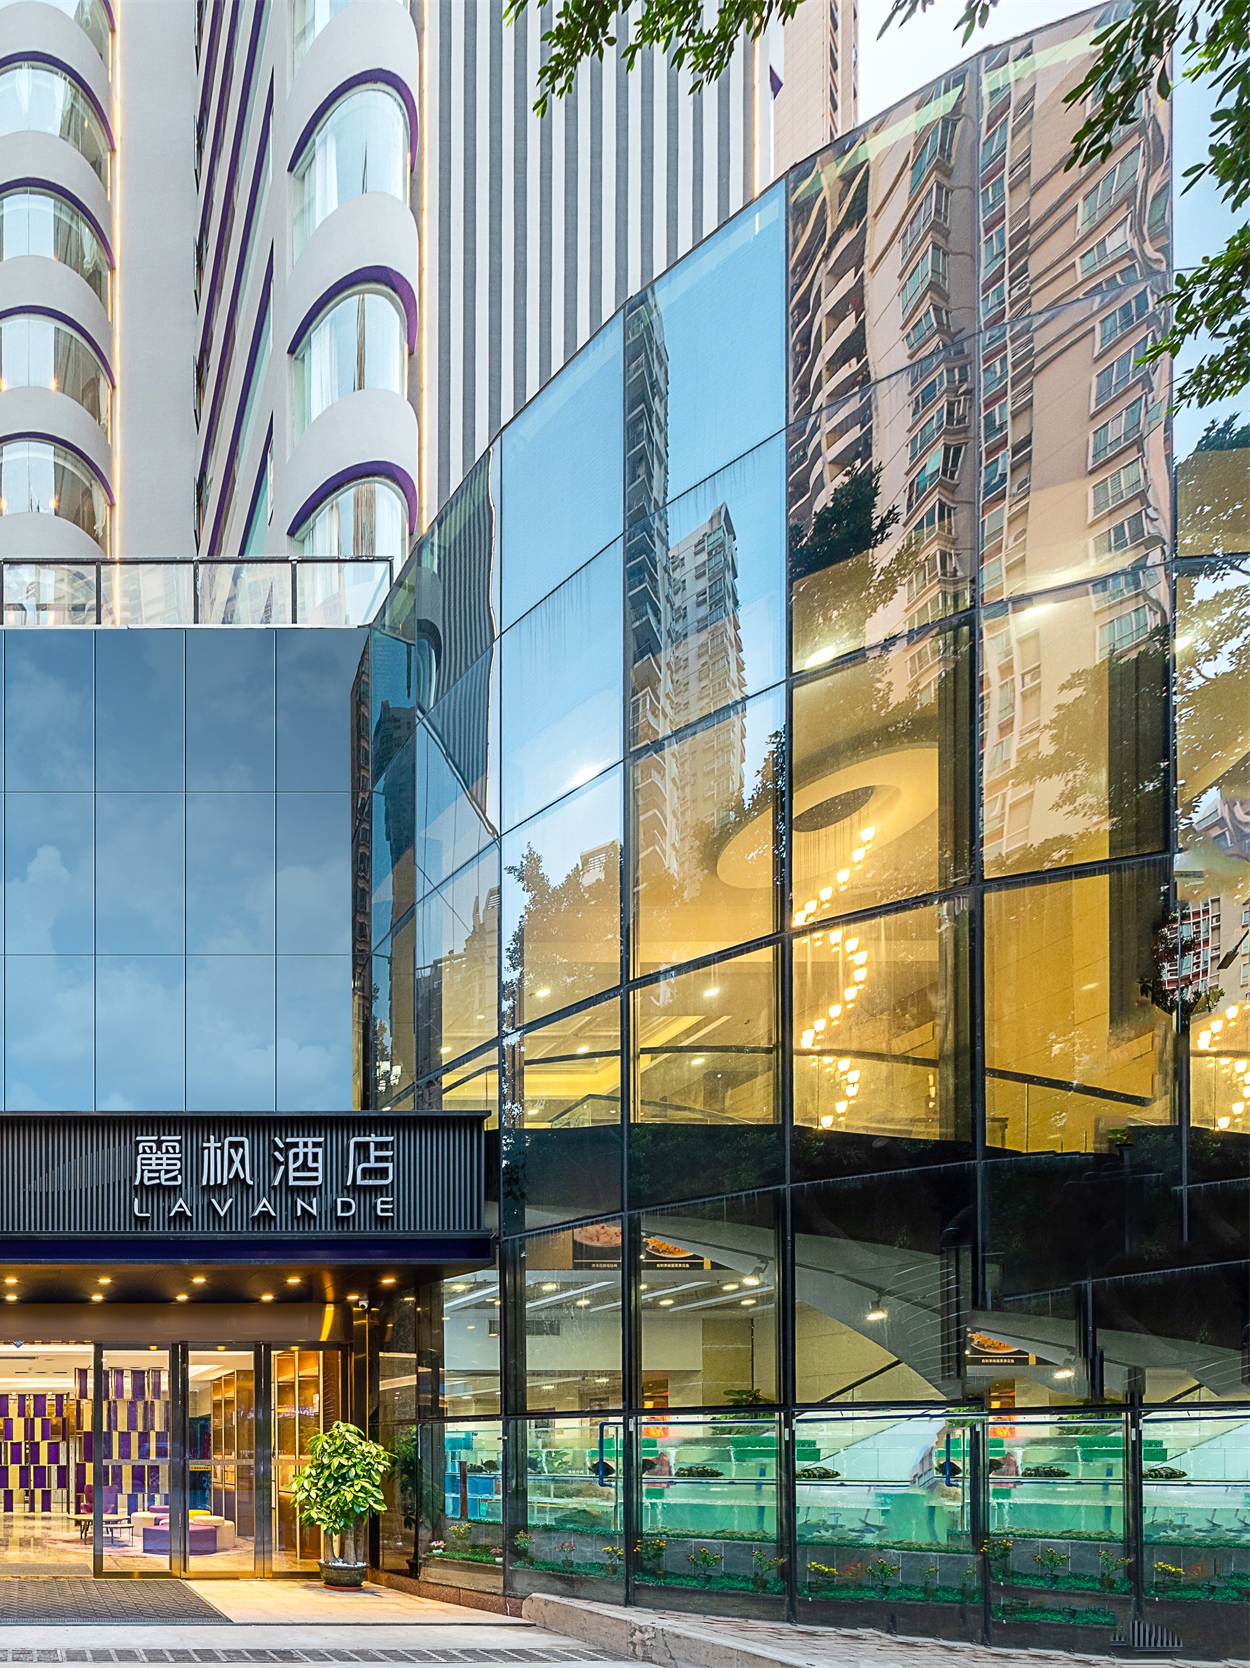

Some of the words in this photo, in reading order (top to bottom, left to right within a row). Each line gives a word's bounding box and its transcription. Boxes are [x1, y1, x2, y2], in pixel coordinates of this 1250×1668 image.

[134, 1134, 395, 1187] 麗枫酒店
[133, 1197, 394, 1217] LAVANDE
